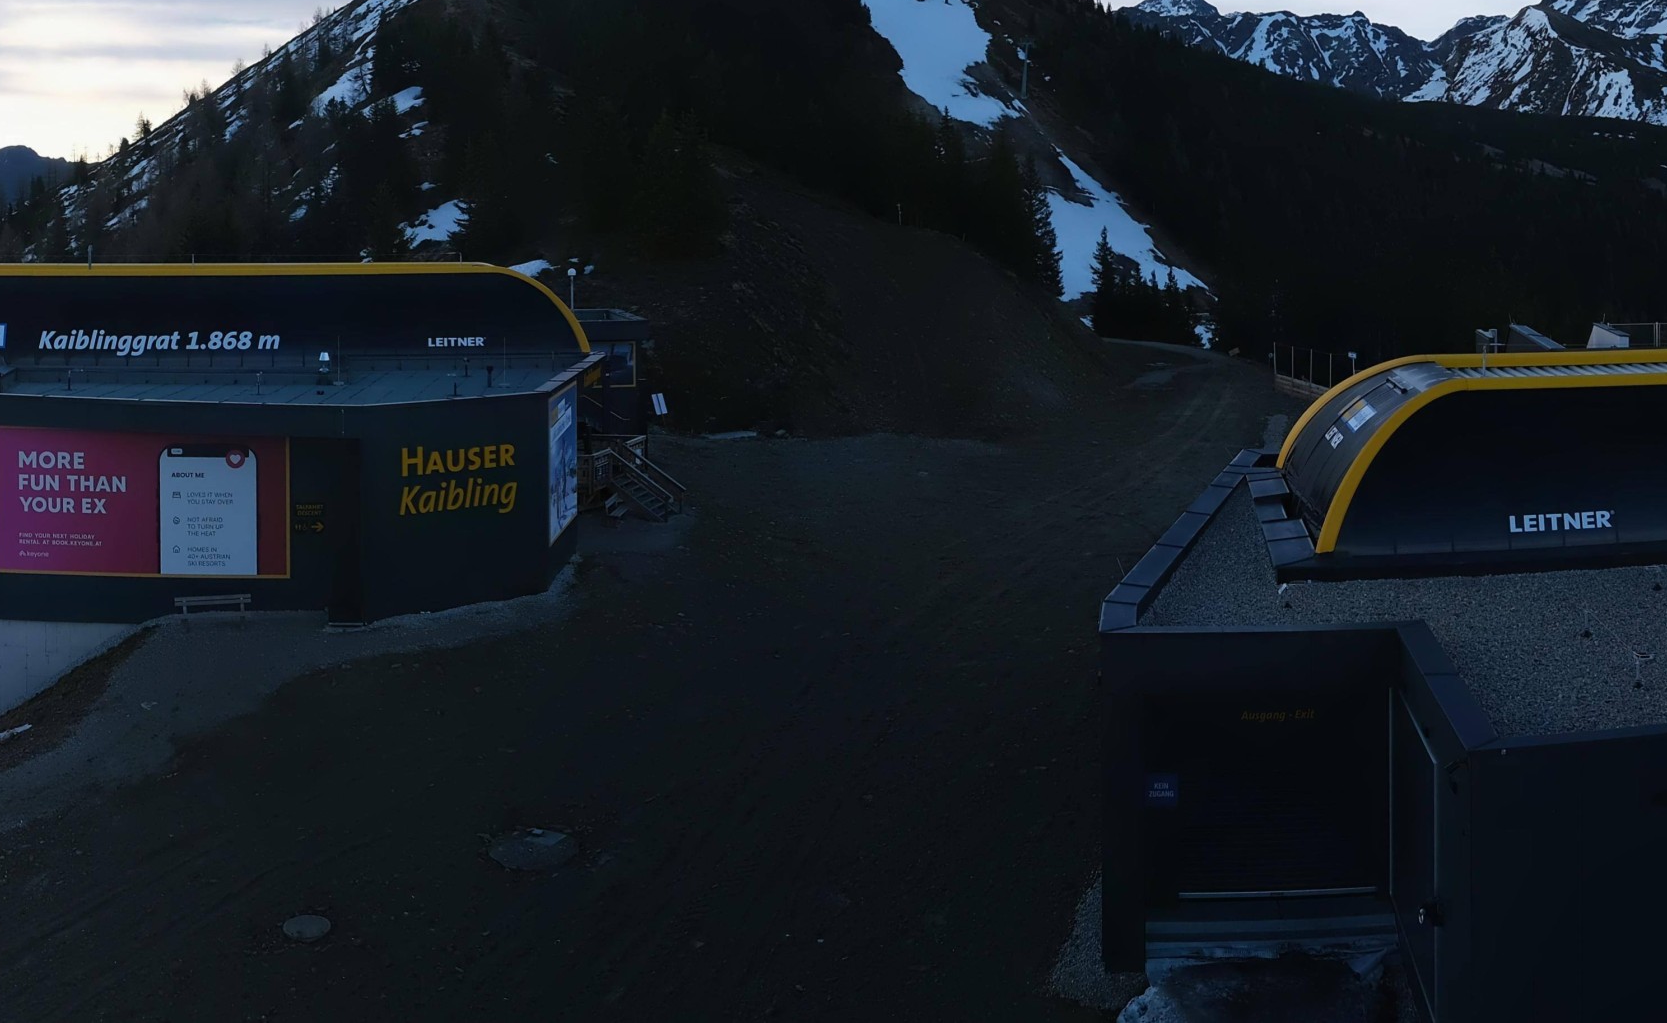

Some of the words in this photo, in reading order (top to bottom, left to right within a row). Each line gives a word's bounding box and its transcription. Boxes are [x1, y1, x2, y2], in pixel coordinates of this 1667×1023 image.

[38, 330, 179, 357] Kaiblinggrat
[186, 330, 252, 350] 1.868
[258, 334, 280, 350] m
[428, 337, 485, 347] LEITNER
[18, 450, 85, 469] MORE
[402, 443, 516, 477] HAUSER
[18, 474, 60, 491] FUN
[67, 475, 127, 492] THAN
[20, 496, 75, 513] YOUR
[81, 498, 107, 514] EX
[399, 477, 518, 515] Kaibling
[1509, 510, 1613, 533] LEITNER
[1241, 710, 1286, 722] Ausgang
[1295, 709, 1315, 719] Exit
